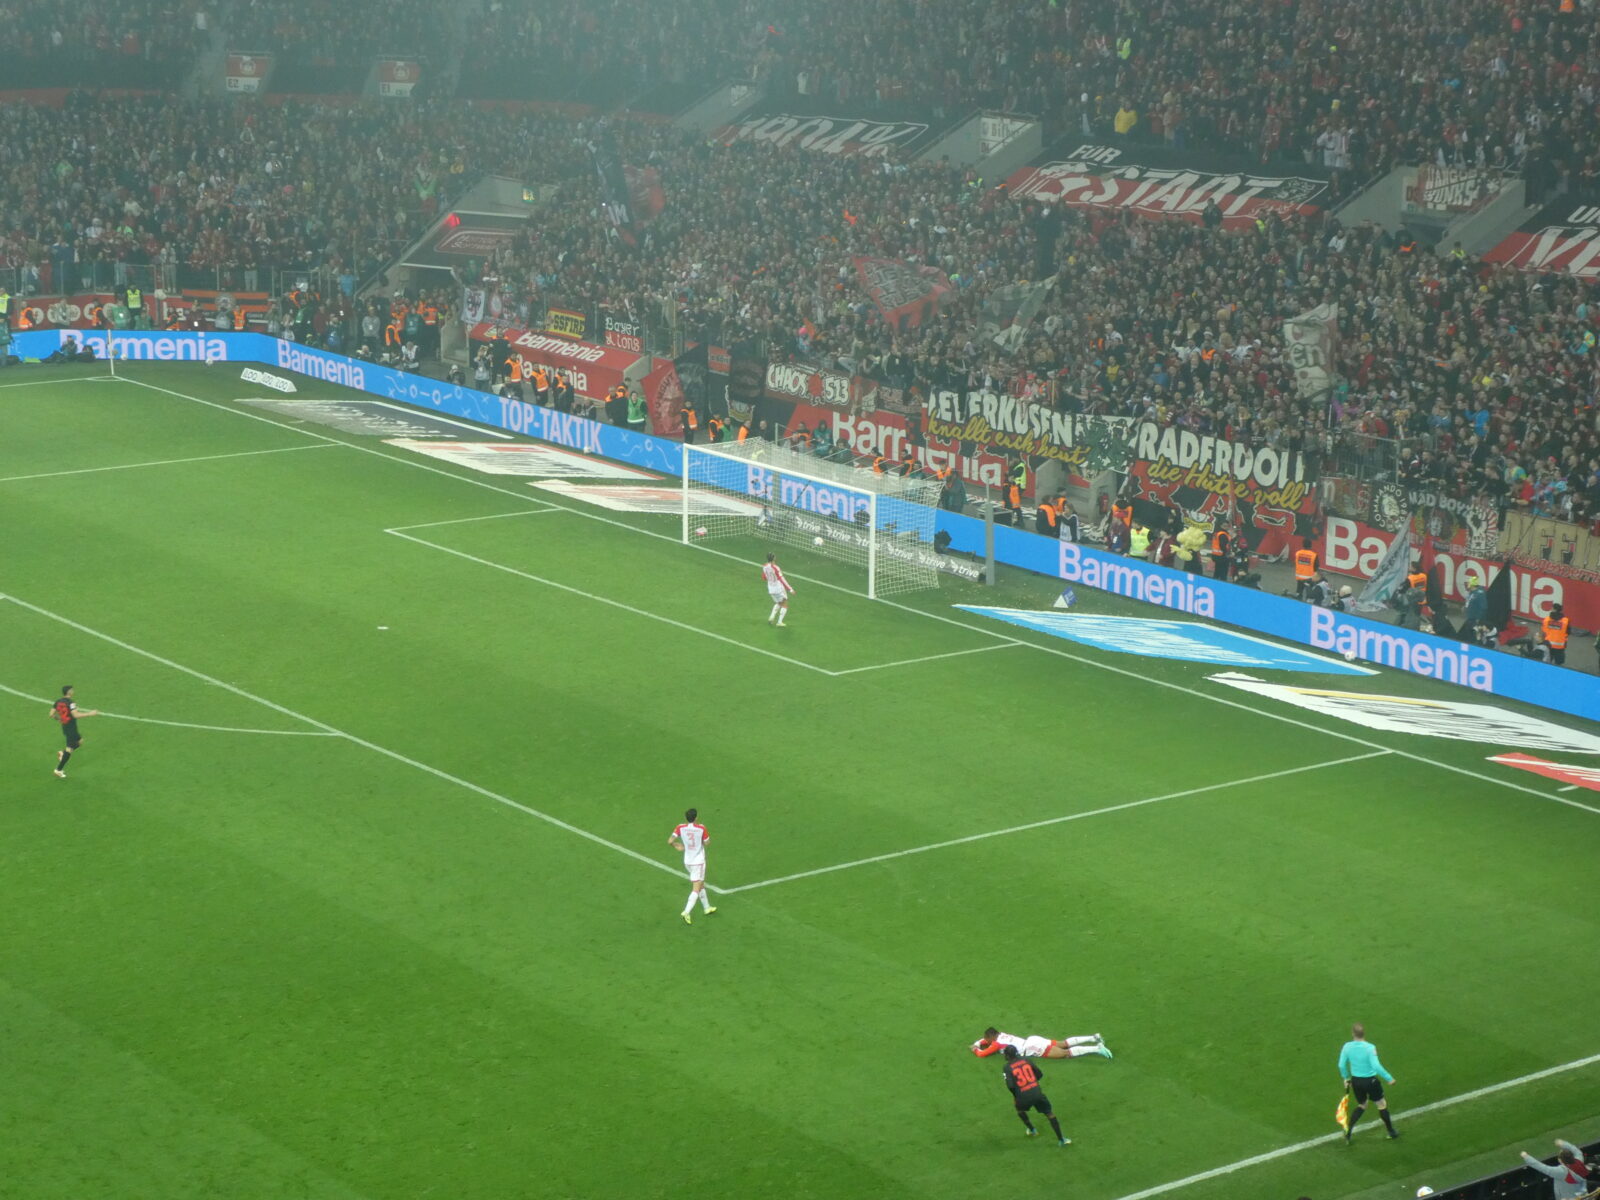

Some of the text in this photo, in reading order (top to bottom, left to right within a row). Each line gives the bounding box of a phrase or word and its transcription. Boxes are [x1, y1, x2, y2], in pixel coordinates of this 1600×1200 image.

[1067, 144, 1122, 164] FÜR
[1079, 164, 1283, 216] STADT
[59, 329, 228, 362] Barmenia
[276, 338, 365, 391] Barmenia
[515, 331, 606, 363] Barmenia
[499, 396, 605, 456] TOP-TAKTIK
[1148, 456, 1183, 480] die
[1253, 480, 1306, 510] voll
[958, 564, 980, 579] trive
[1058, 541, 1215, 618] Barmenia
[1325, 515, 1564, 618] Baenia
[1310, 604, 1494, 693] Barmenia
[1011, 1063, 1037, 1088] 30
